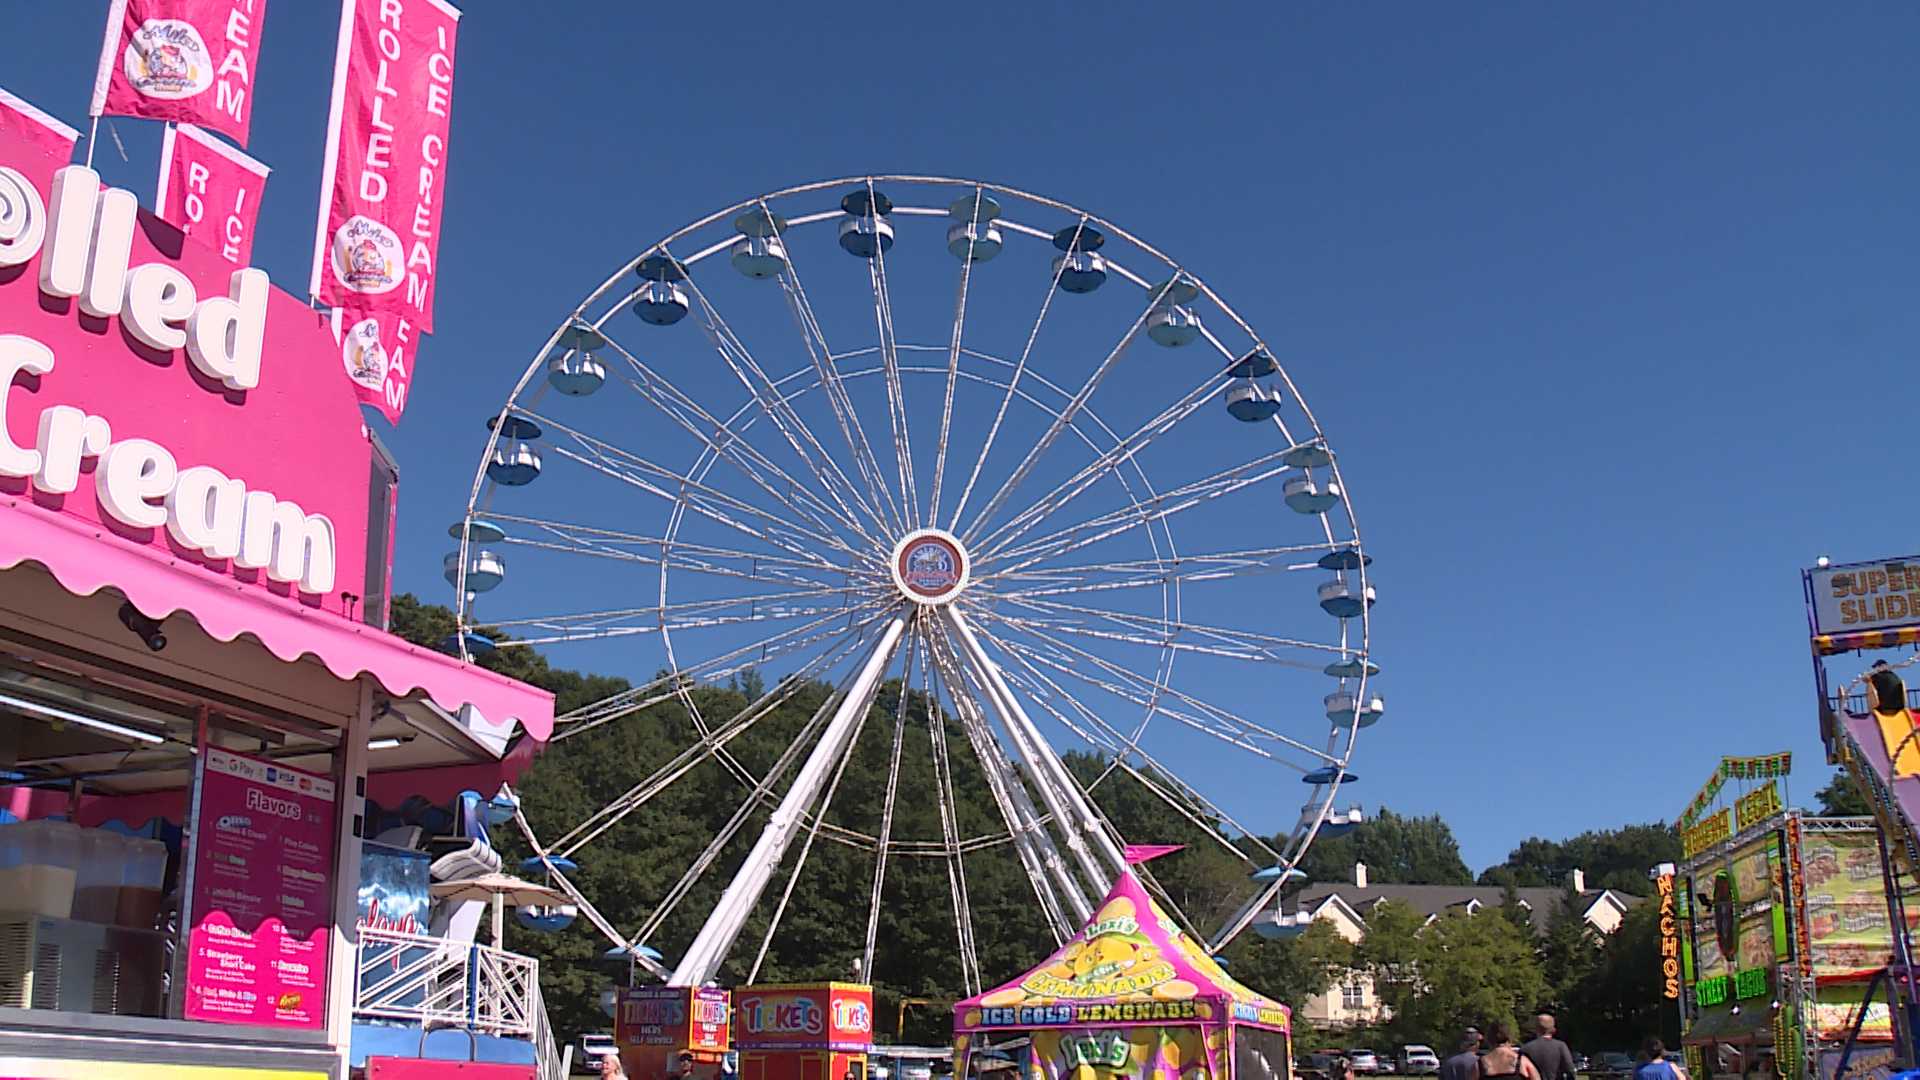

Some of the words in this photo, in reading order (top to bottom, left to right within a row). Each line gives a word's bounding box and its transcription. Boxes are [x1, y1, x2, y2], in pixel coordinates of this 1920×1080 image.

[216, 0, 252, 123] EAM
[427, 26, 450, 117] ICE
[360, 0, 403, 203] ROLLED
[182, 161, 210, 234] RO
[406, 134, 442, 312] CREAM
[1840, 592, 1920, 624] SLIDE
[248, 789, 301, 819] Flavors
[1087, 918, 1137, 938] Lexi's
[1657, 874, 1679, 999] NACHOS
[1695, 975, 1730, 1007] STREET
[742, 998, 824, 1033] TICKETS
[832, 999, 870, 1032] TICKETS
[981, 1007, 1015, 1025] ICE
[1020, 1006, 1071, 1025] COLD
[1077, 1001, 1194, 1022] LEMONADE
[1061, 1034, 1126, 1064] Lexi's
